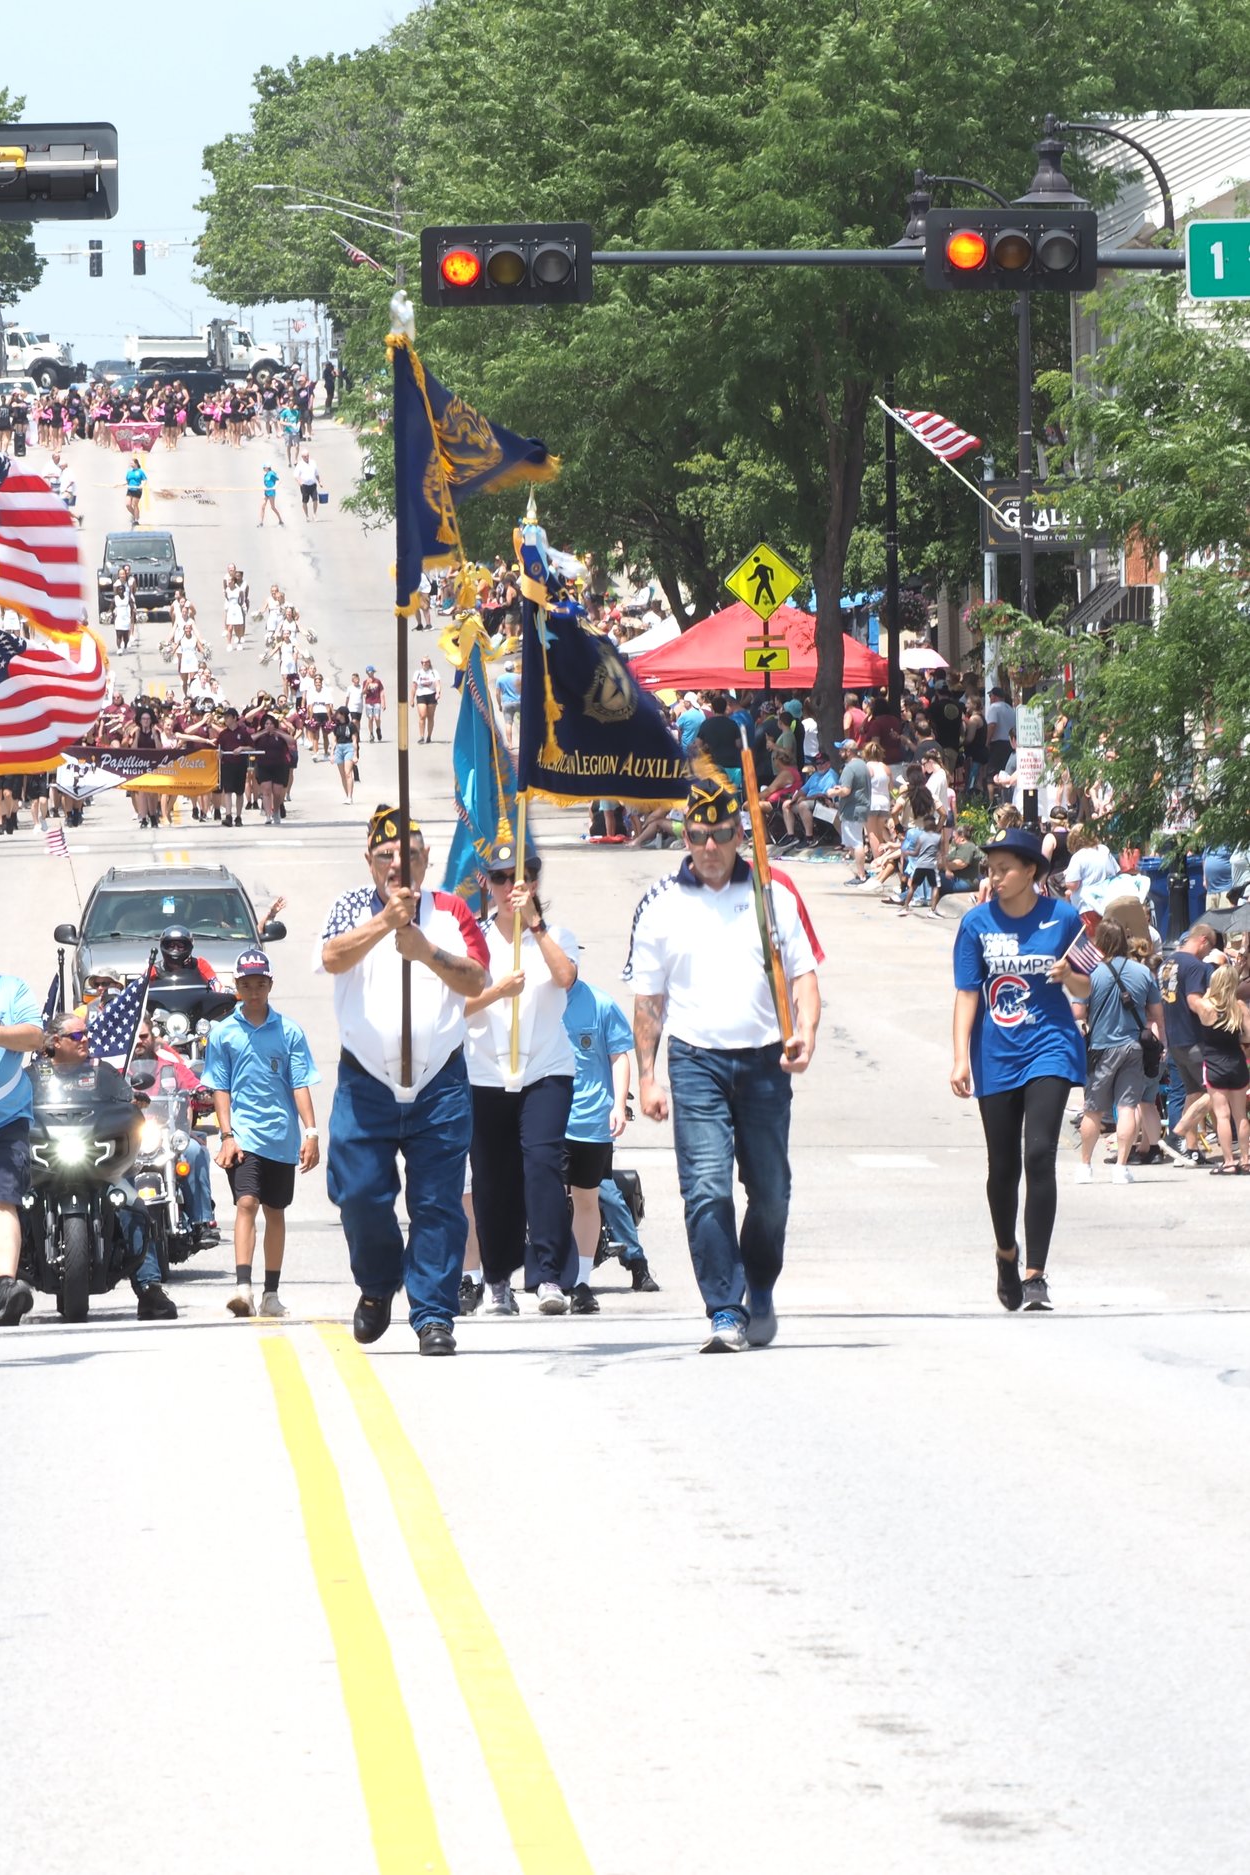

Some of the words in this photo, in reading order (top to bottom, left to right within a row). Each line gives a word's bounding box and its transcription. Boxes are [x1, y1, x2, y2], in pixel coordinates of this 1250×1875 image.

[1210, 241, 1224, 280] 1
[178, 755, 206, 769] Vista
[575, 750, 619, 776] LEGION
